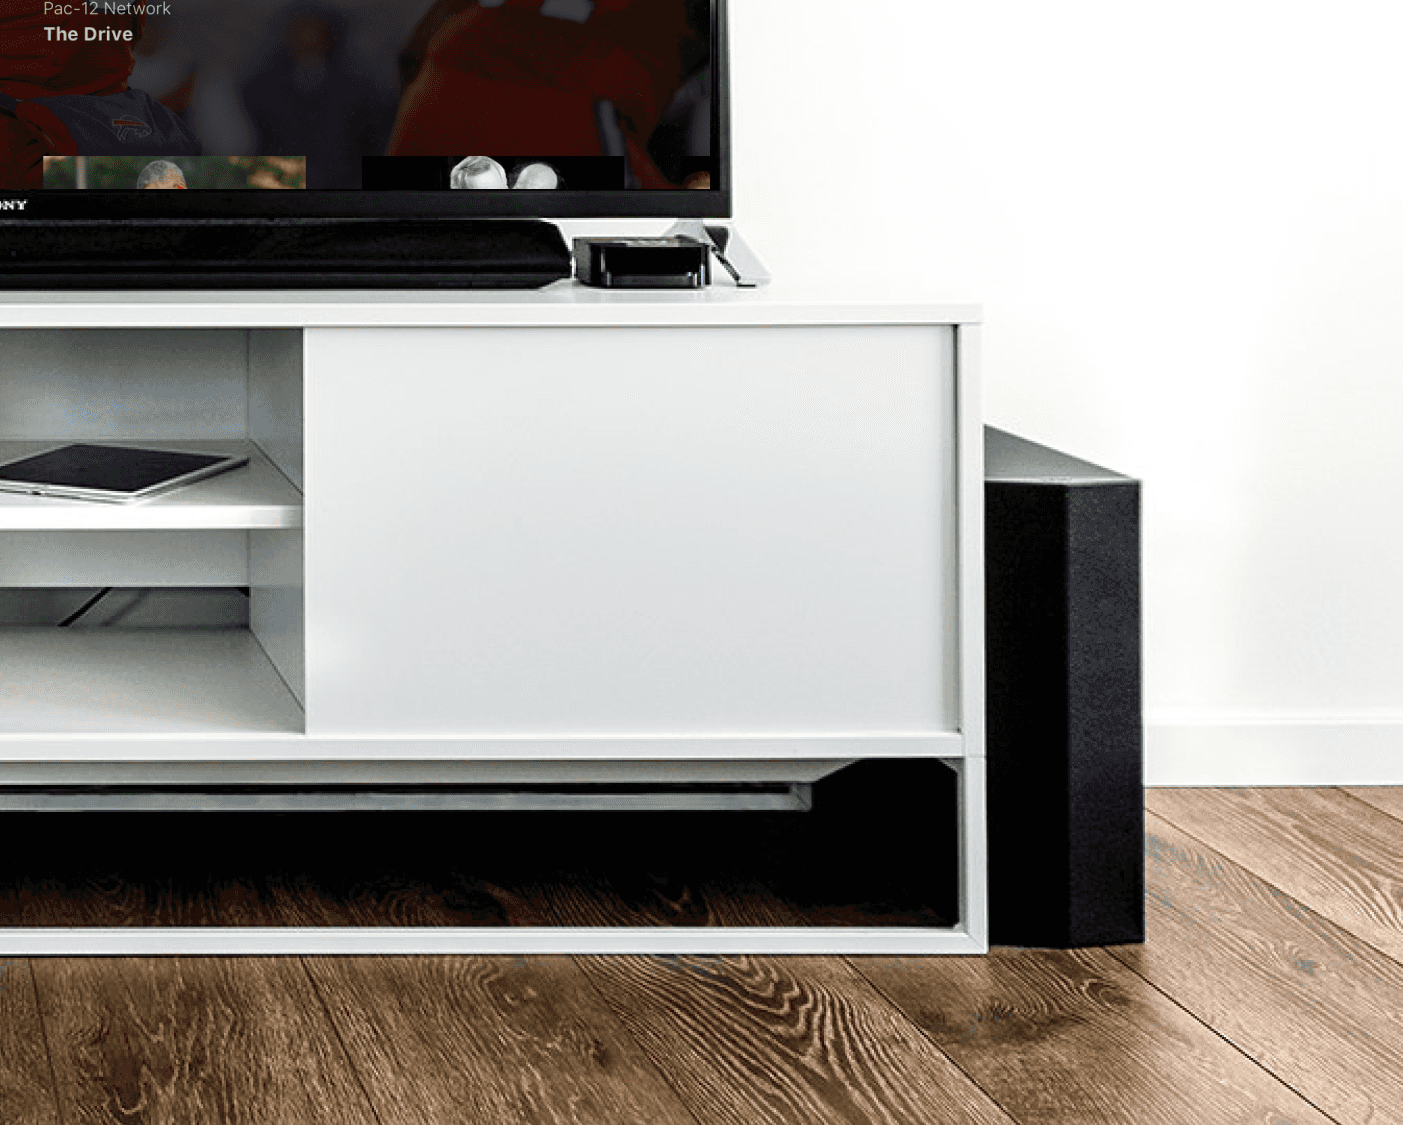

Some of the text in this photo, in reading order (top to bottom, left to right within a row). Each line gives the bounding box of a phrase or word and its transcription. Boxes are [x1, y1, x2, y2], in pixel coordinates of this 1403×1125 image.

[44, 1, 171, 15] Pac-12 Network
[44, 26, 133, 41] The Drive
